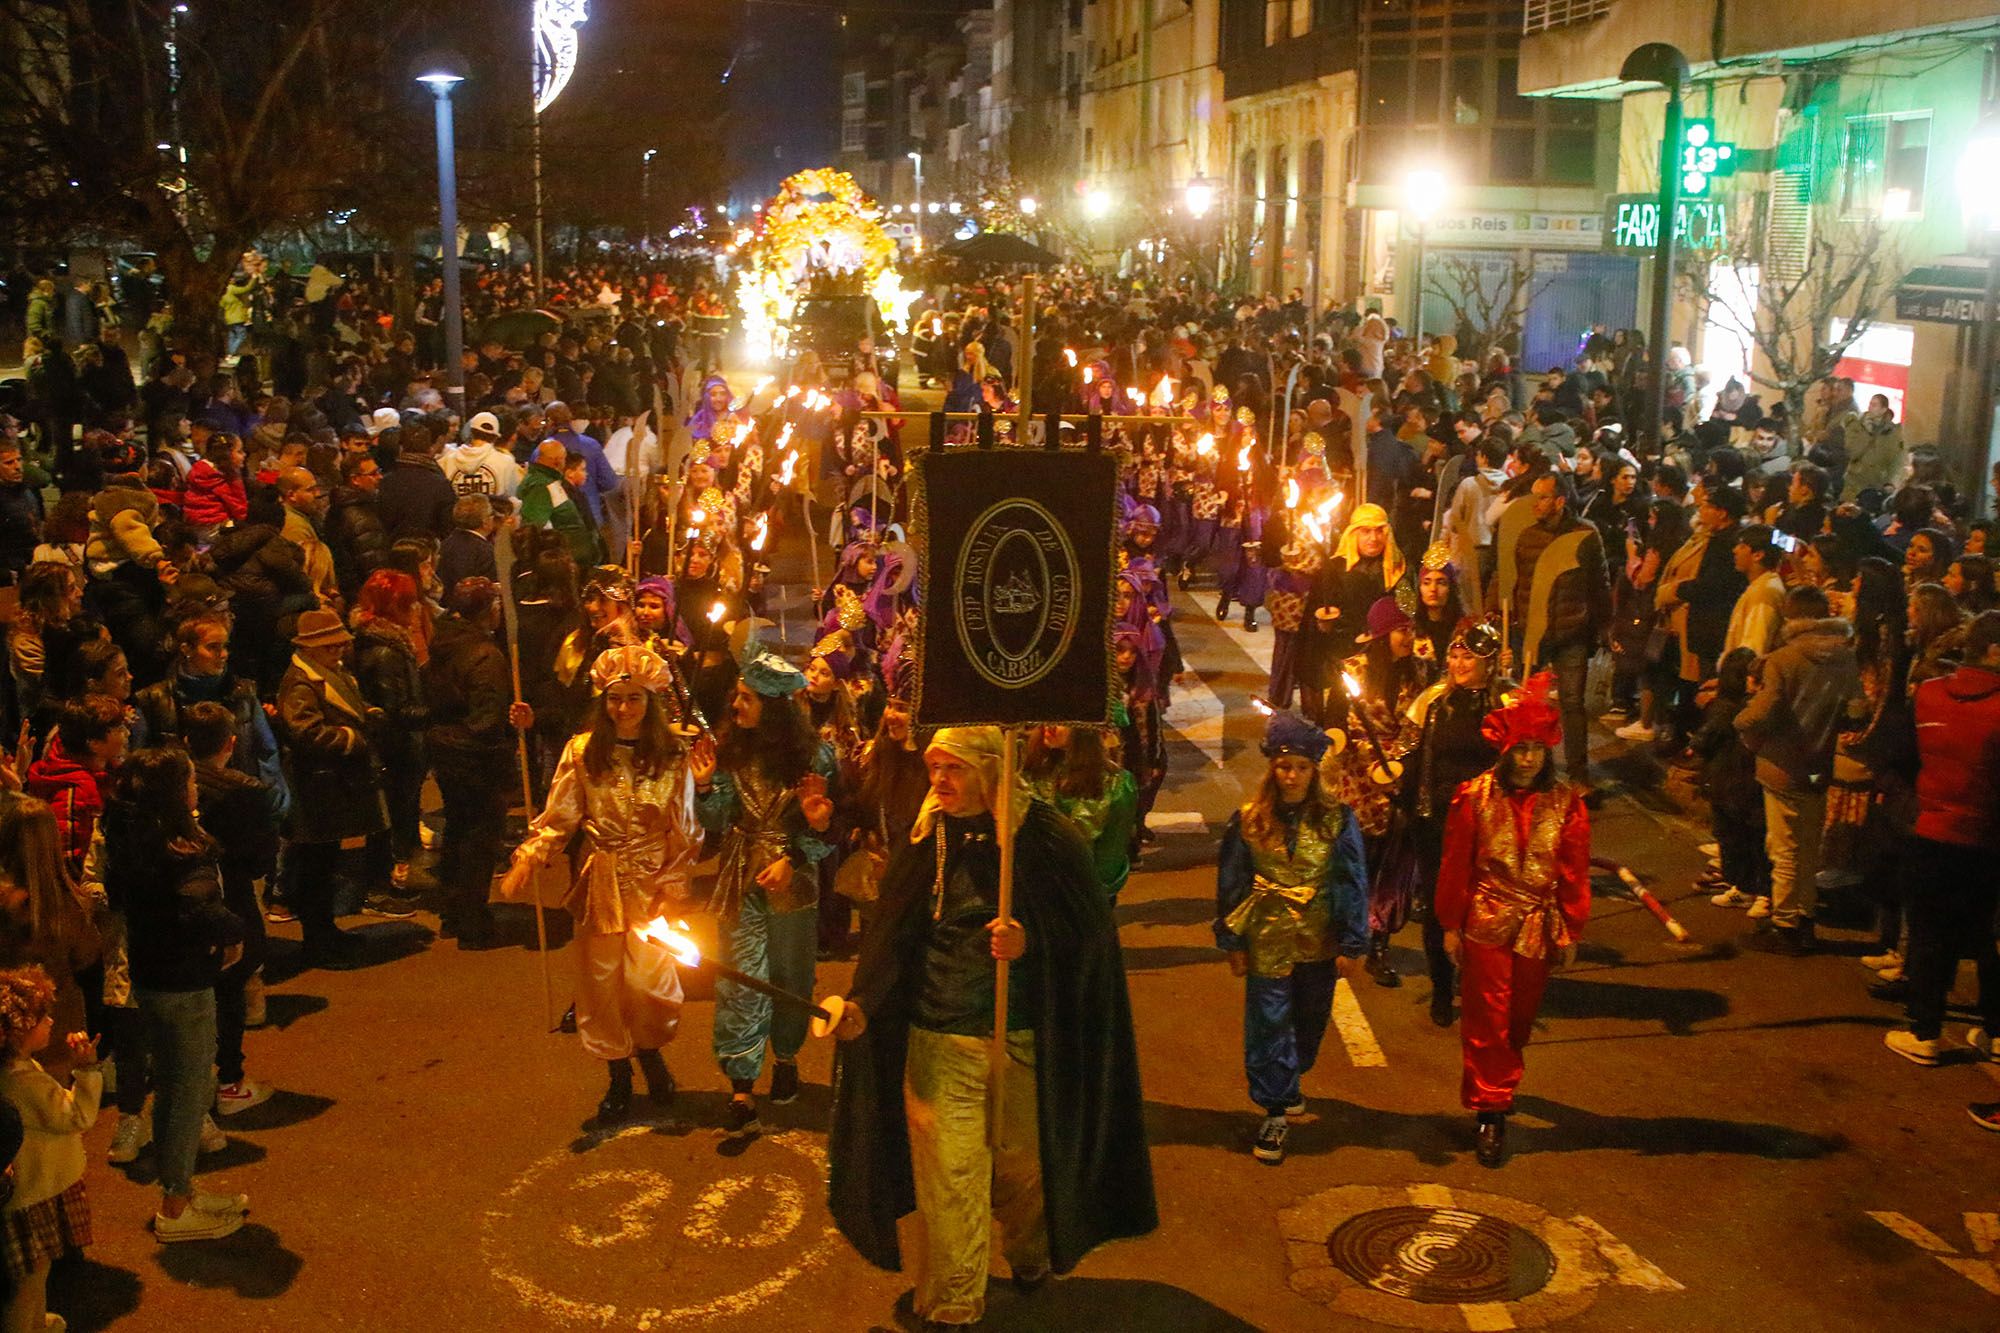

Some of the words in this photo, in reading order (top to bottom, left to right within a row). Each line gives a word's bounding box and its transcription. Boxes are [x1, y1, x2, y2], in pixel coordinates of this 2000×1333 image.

[1682, 146, 1731, 172] 13°
[1471, 216, 1508, 231] Reis
[1616, 203, 1728, 249] FARACIA
[1940, 298, 2000, 321] AVEN
[1035, 530, 1062, 552] DE
[964, 595, 986, 631] CEIP
[1047, 574, 1071, 631] CASTRO
[986, 650, 1046, 679] CARRIL
[560, 1168, 805, 1249] 30
